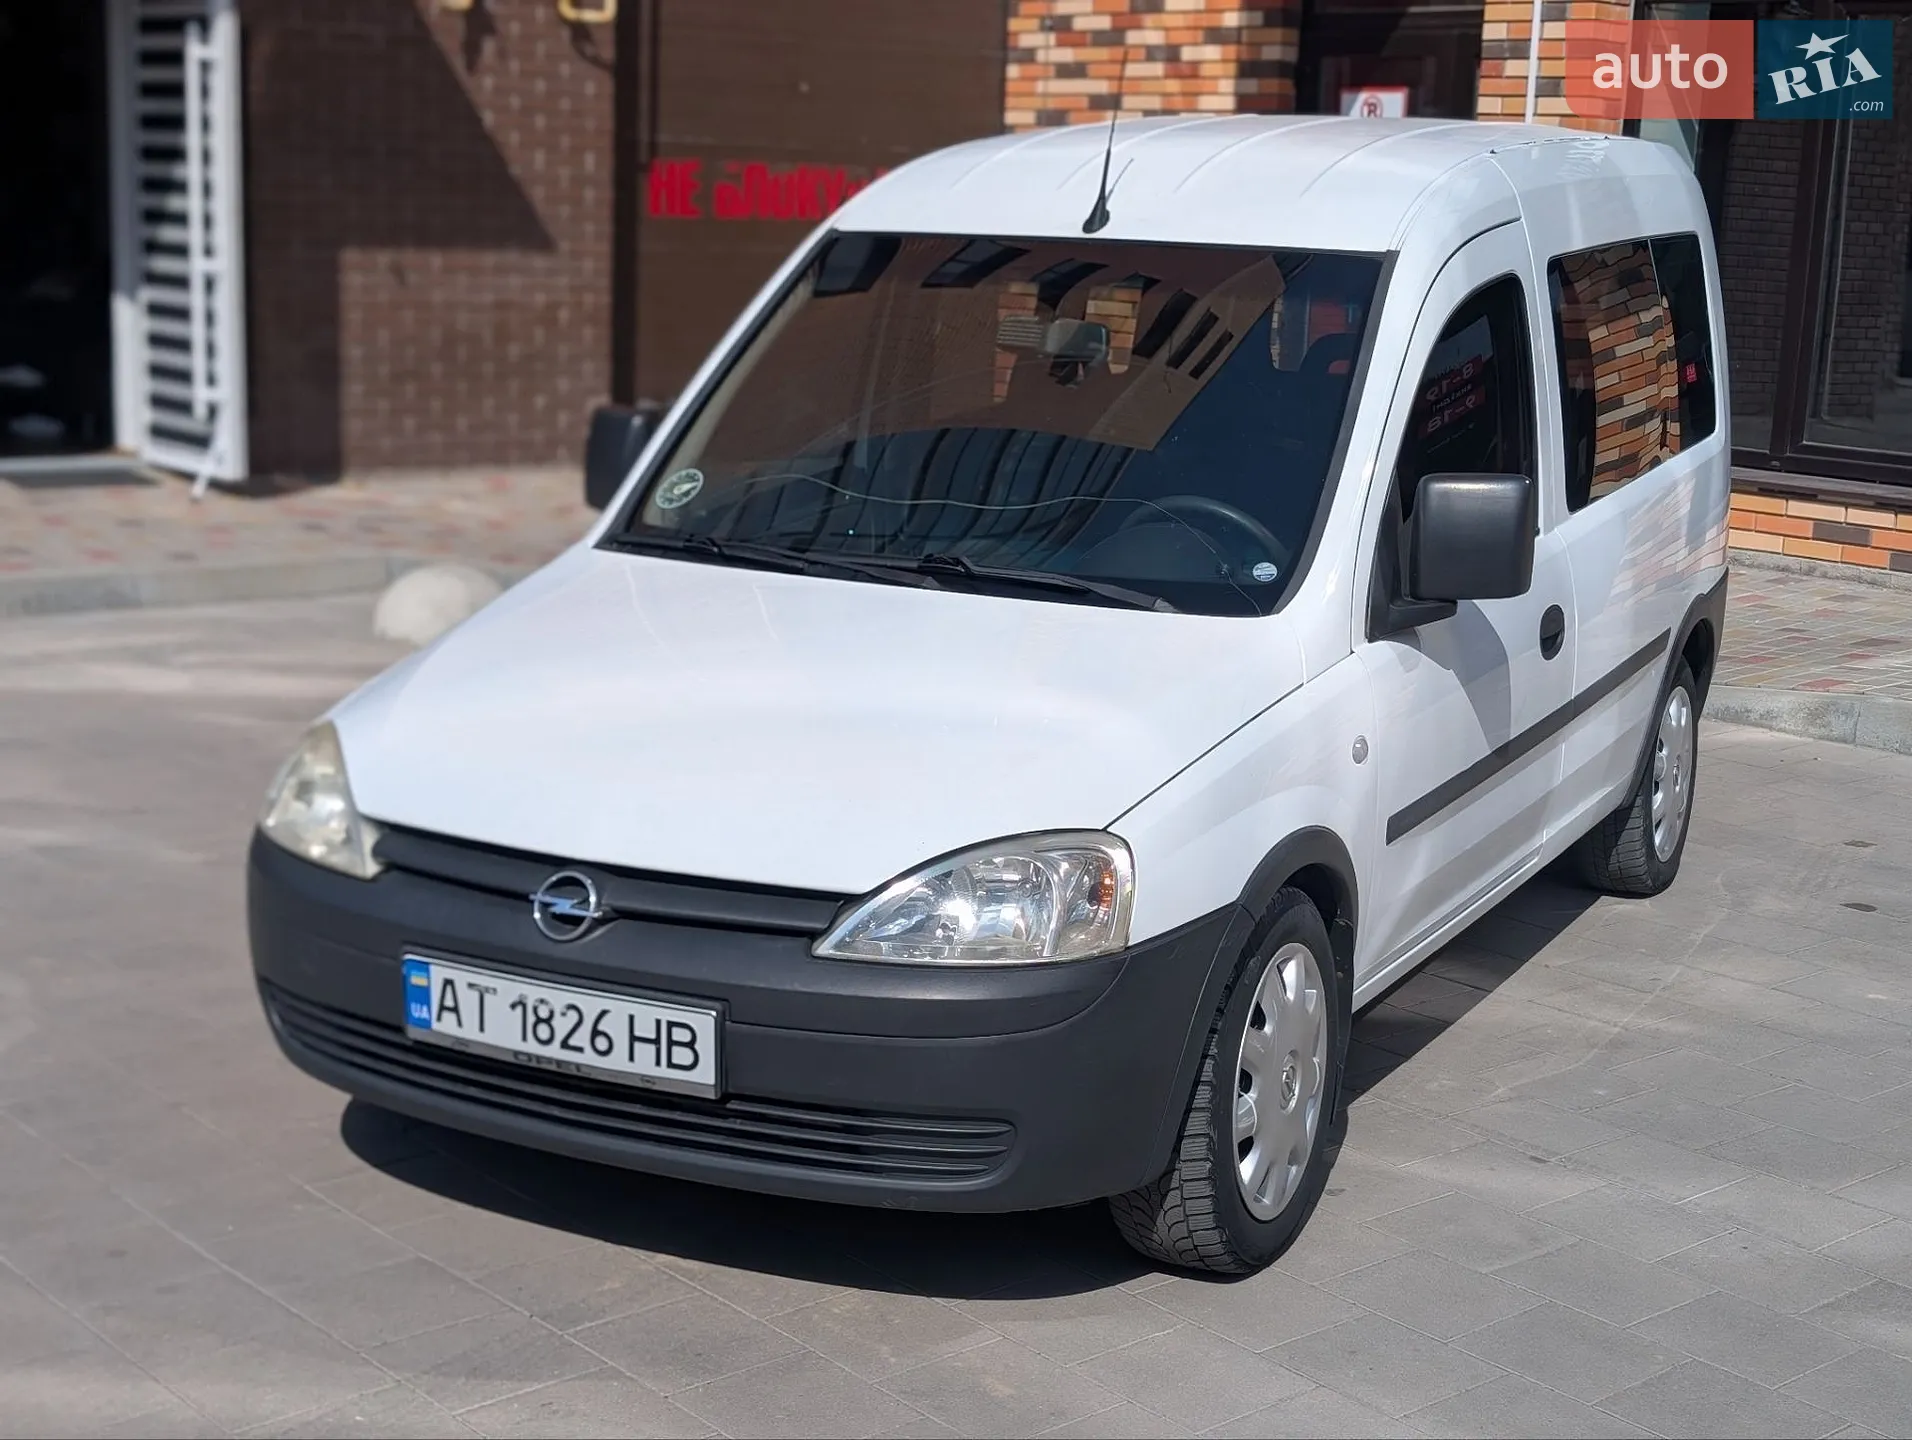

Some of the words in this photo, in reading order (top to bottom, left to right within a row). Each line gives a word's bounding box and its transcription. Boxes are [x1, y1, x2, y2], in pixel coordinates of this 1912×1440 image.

[648, 158, 702, 218] НЕ
[410, 1001, 430, 1020] UA
[436, 978, 498, 1034] AT
[510, 994, 614, 1058] 1826
[628, 1013, 700, 1072] HB
